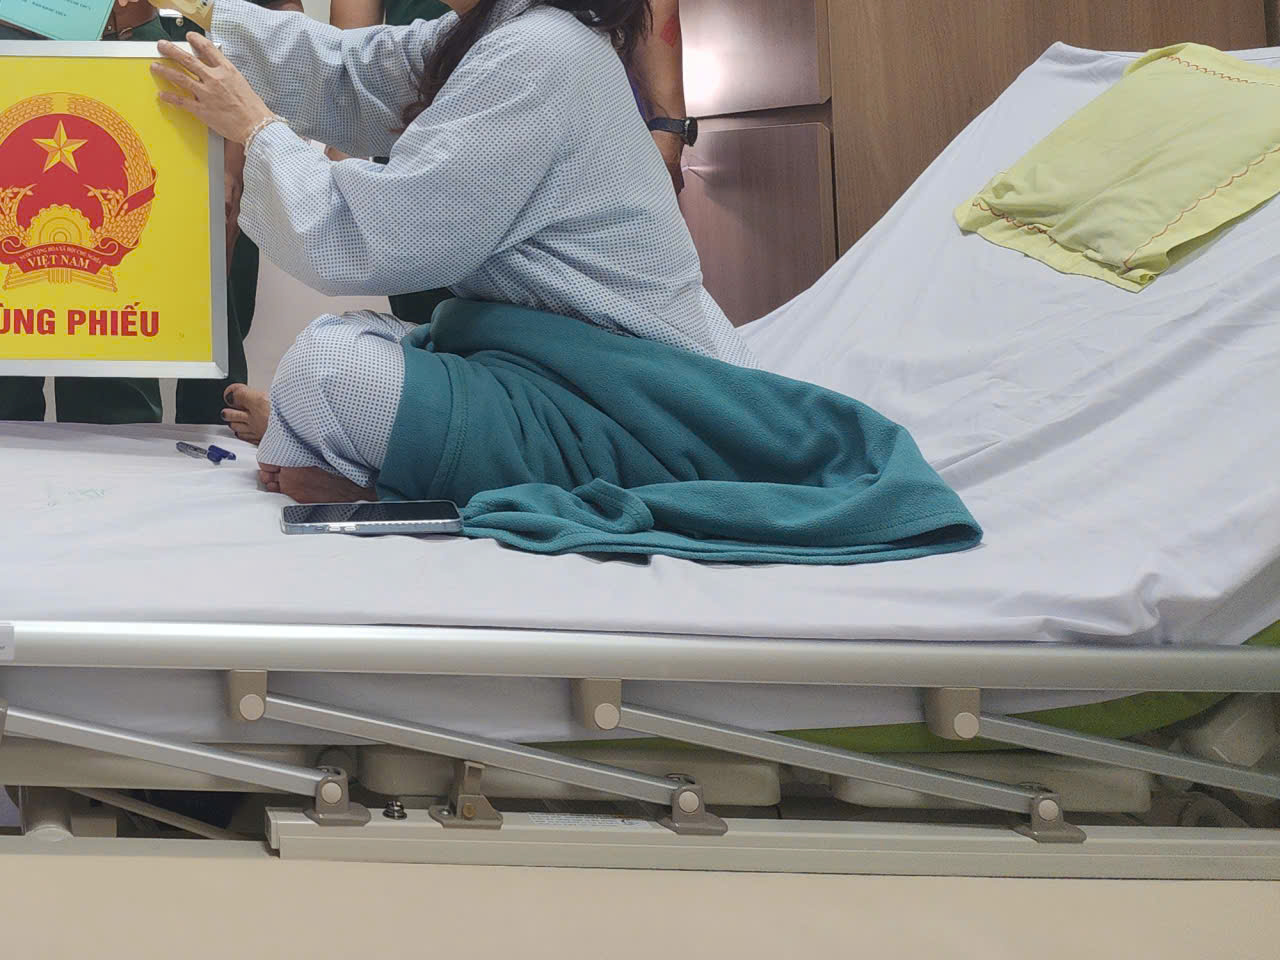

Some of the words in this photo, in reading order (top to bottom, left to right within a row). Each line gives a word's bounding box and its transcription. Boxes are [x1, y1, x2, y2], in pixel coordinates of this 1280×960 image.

[27, 254, 59, 268] VIỆT
[60, 254, 90, 269] NAM
[67, 302, 160, 337] PHIẾU
